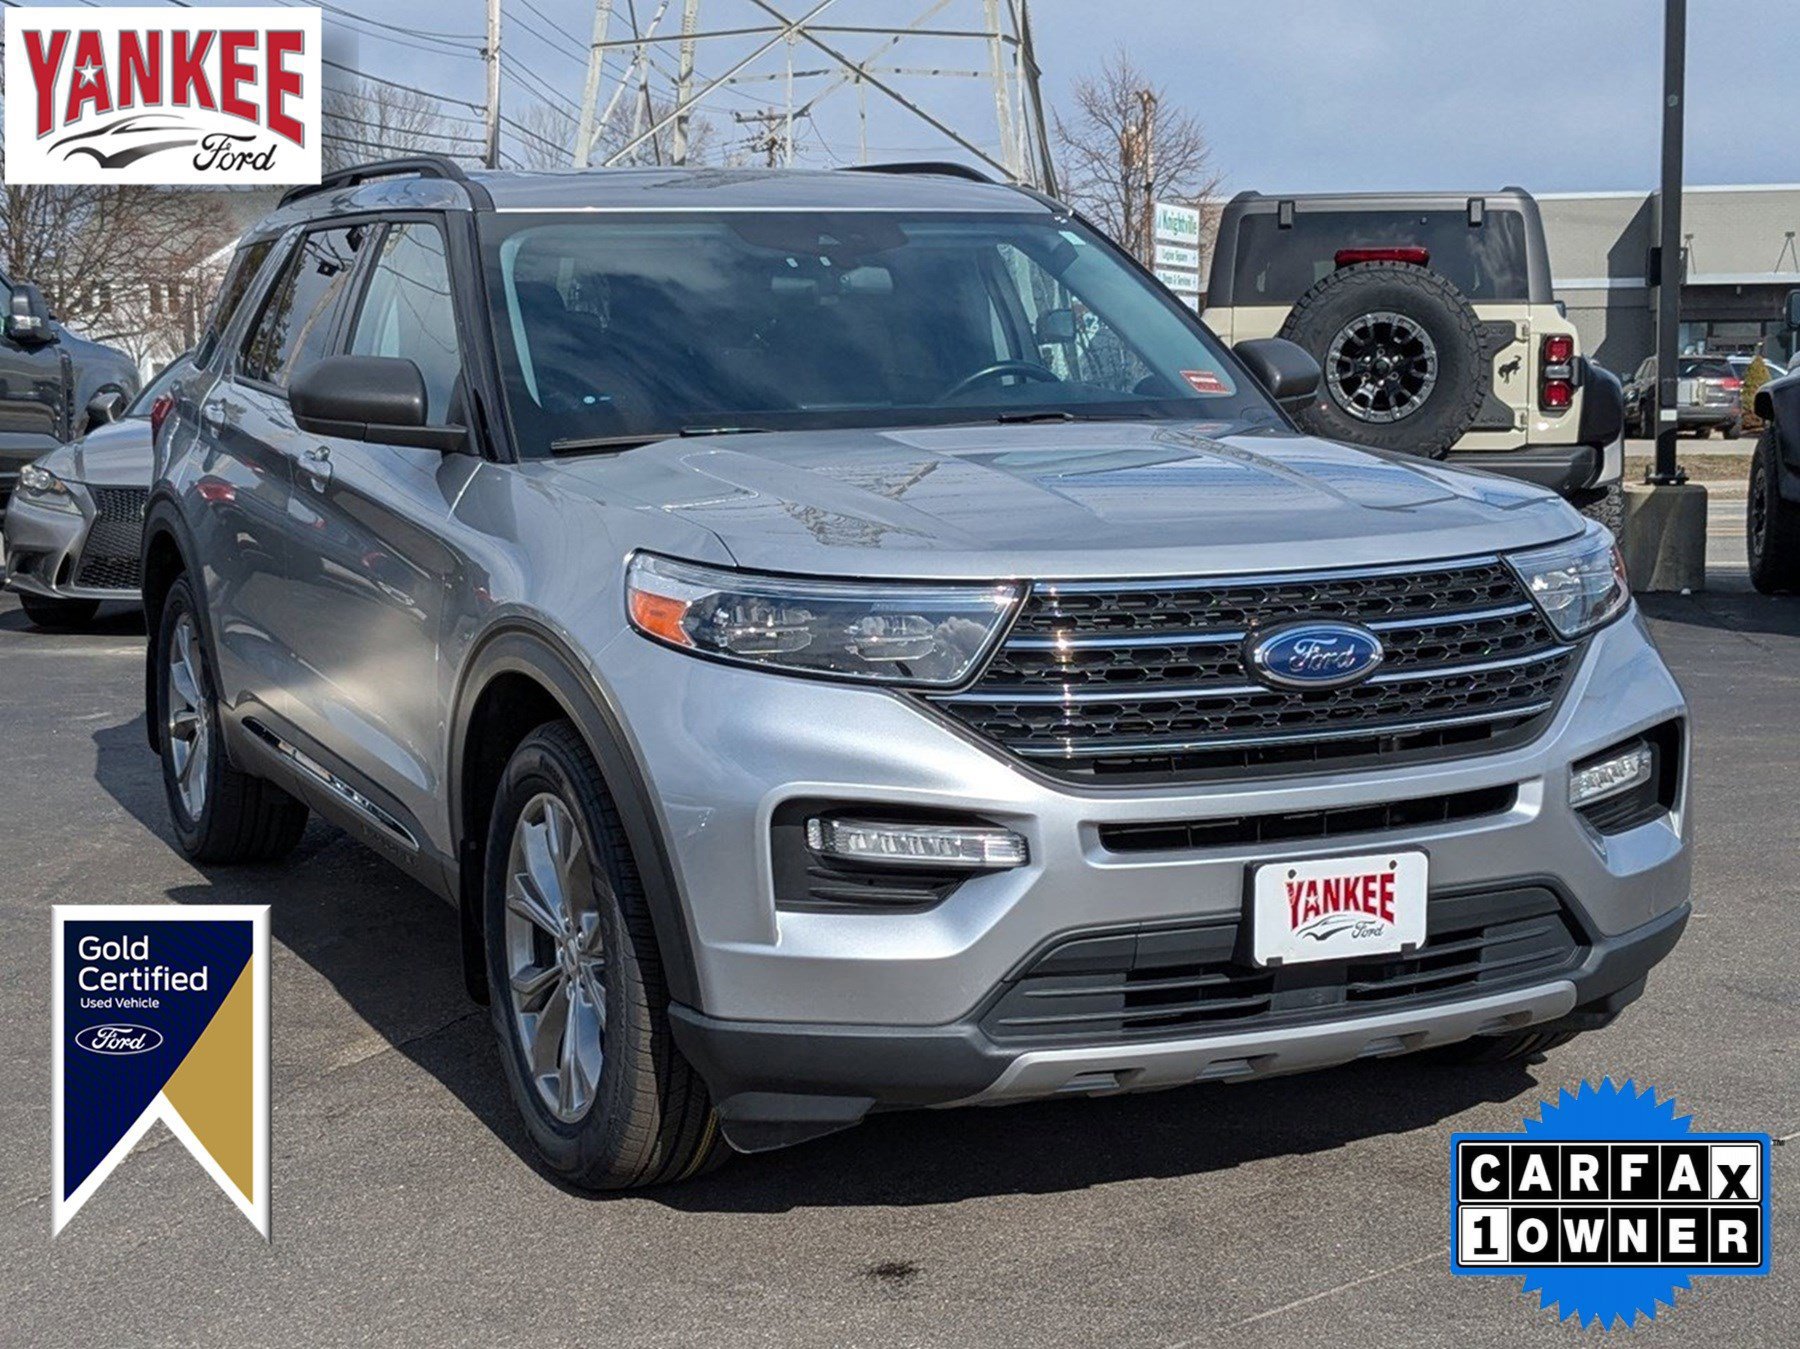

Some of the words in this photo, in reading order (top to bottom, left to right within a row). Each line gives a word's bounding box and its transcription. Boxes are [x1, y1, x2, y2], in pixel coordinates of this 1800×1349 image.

[1289, 637, 1356, 673] Ford
[1284, 872, 1396, 932] YANKEE
[1351, 920, 1384, 939] Ford
